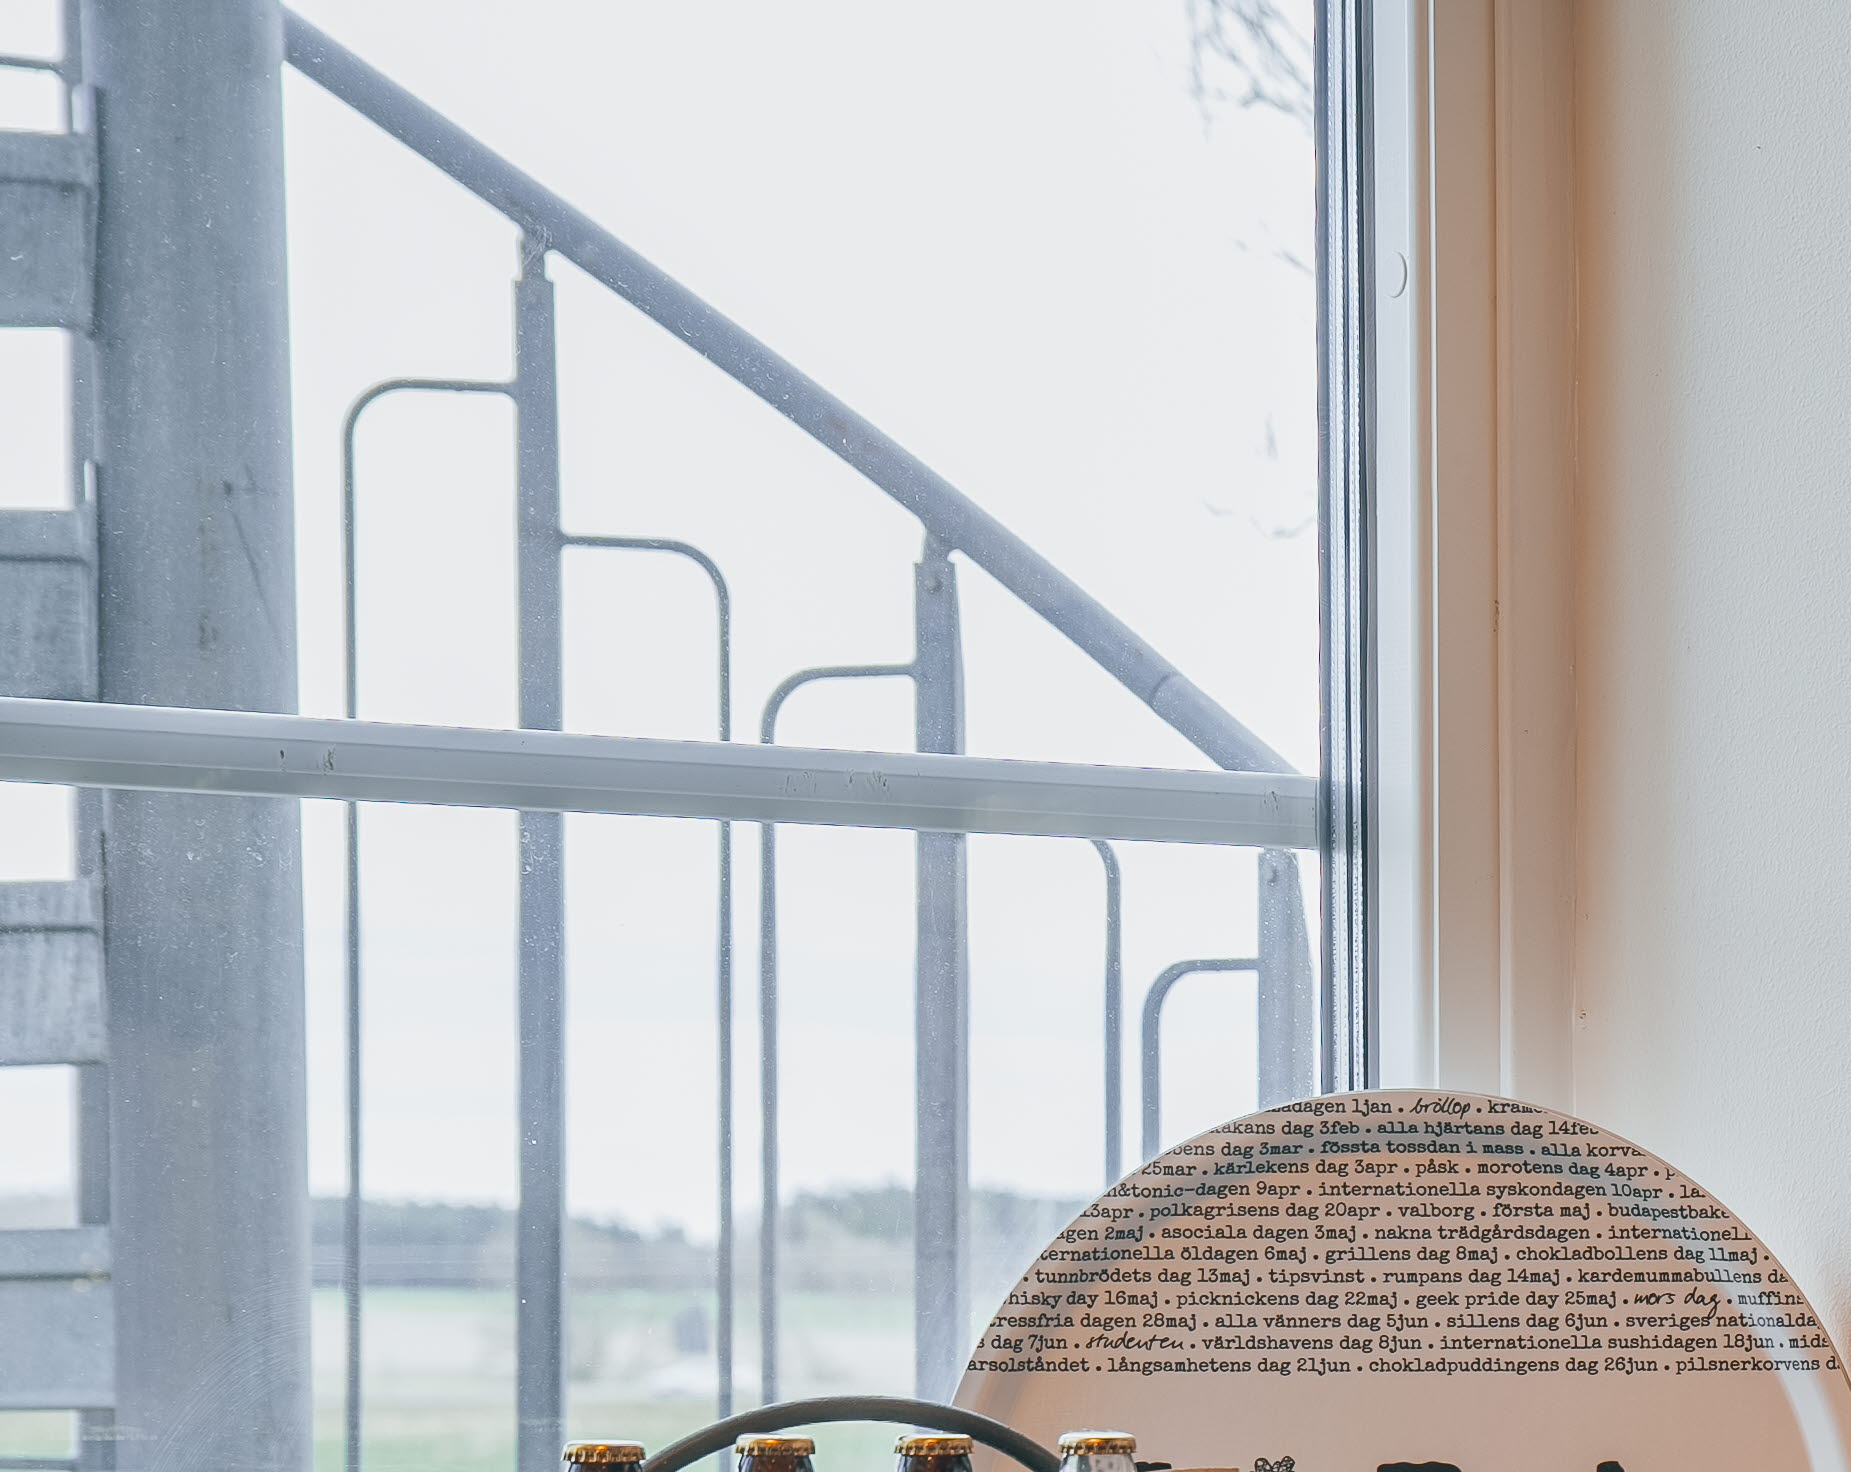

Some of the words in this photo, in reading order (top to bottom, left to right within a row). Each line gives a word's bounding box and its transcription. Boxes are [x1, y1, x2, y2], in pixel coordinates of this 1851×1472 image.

[1148, 1202, 1280, 1222] polkagrisens
[1285, 1201, 1320, 1221] dag
[1324, 1201, 1381, 1222] 20apr
[1397, 1202, 1476, 1222] valborg
[1491, 1202, 1555, 1218] första
[1559, 1202, 1591, 1222] maj
[1180, 1245, 1260, 1265] öldagen
[1264, 1245, 1307, 1265] 6maj
[1324, 1246, 1412, 1265] grillens
[1416, 1245, 1451, 1265] dag
[1455, 1245, 1498, 1265] 8maj
[1515, 1245, 1669, 1261] chokladbollens
[1673, 1245, 1706, 1265] dag
[1065, 1290, 1100, 1310] day
[1175, 1290, 1300, 1310] picknickens
[1304, 1290, 1340, 1310] dag
[1344, 1290, 1398, 1310] 22maj
[1415, 1290, 1460, 1310] geek
[1464, 1290, 1521, 1310] pride
[1525, 1290, 1560, 1310] day
[1564, 1290, 1617, 1310] 25maj
[1683, 1285, 1725, 1321] dag
[990, 1334, 1024, 1354] dag
[1027, 1333, 1069, 1354] 7jun
[1200, 1334, 1334, 1350] världshavens
[1339, 1334, 1374, 1354] dag
[1378, 1334, 1423, 1354] 8jun
[1439, 1334, 1604, 1351] internationella
[1607, 1334, 1719, 1353] sushidagen
